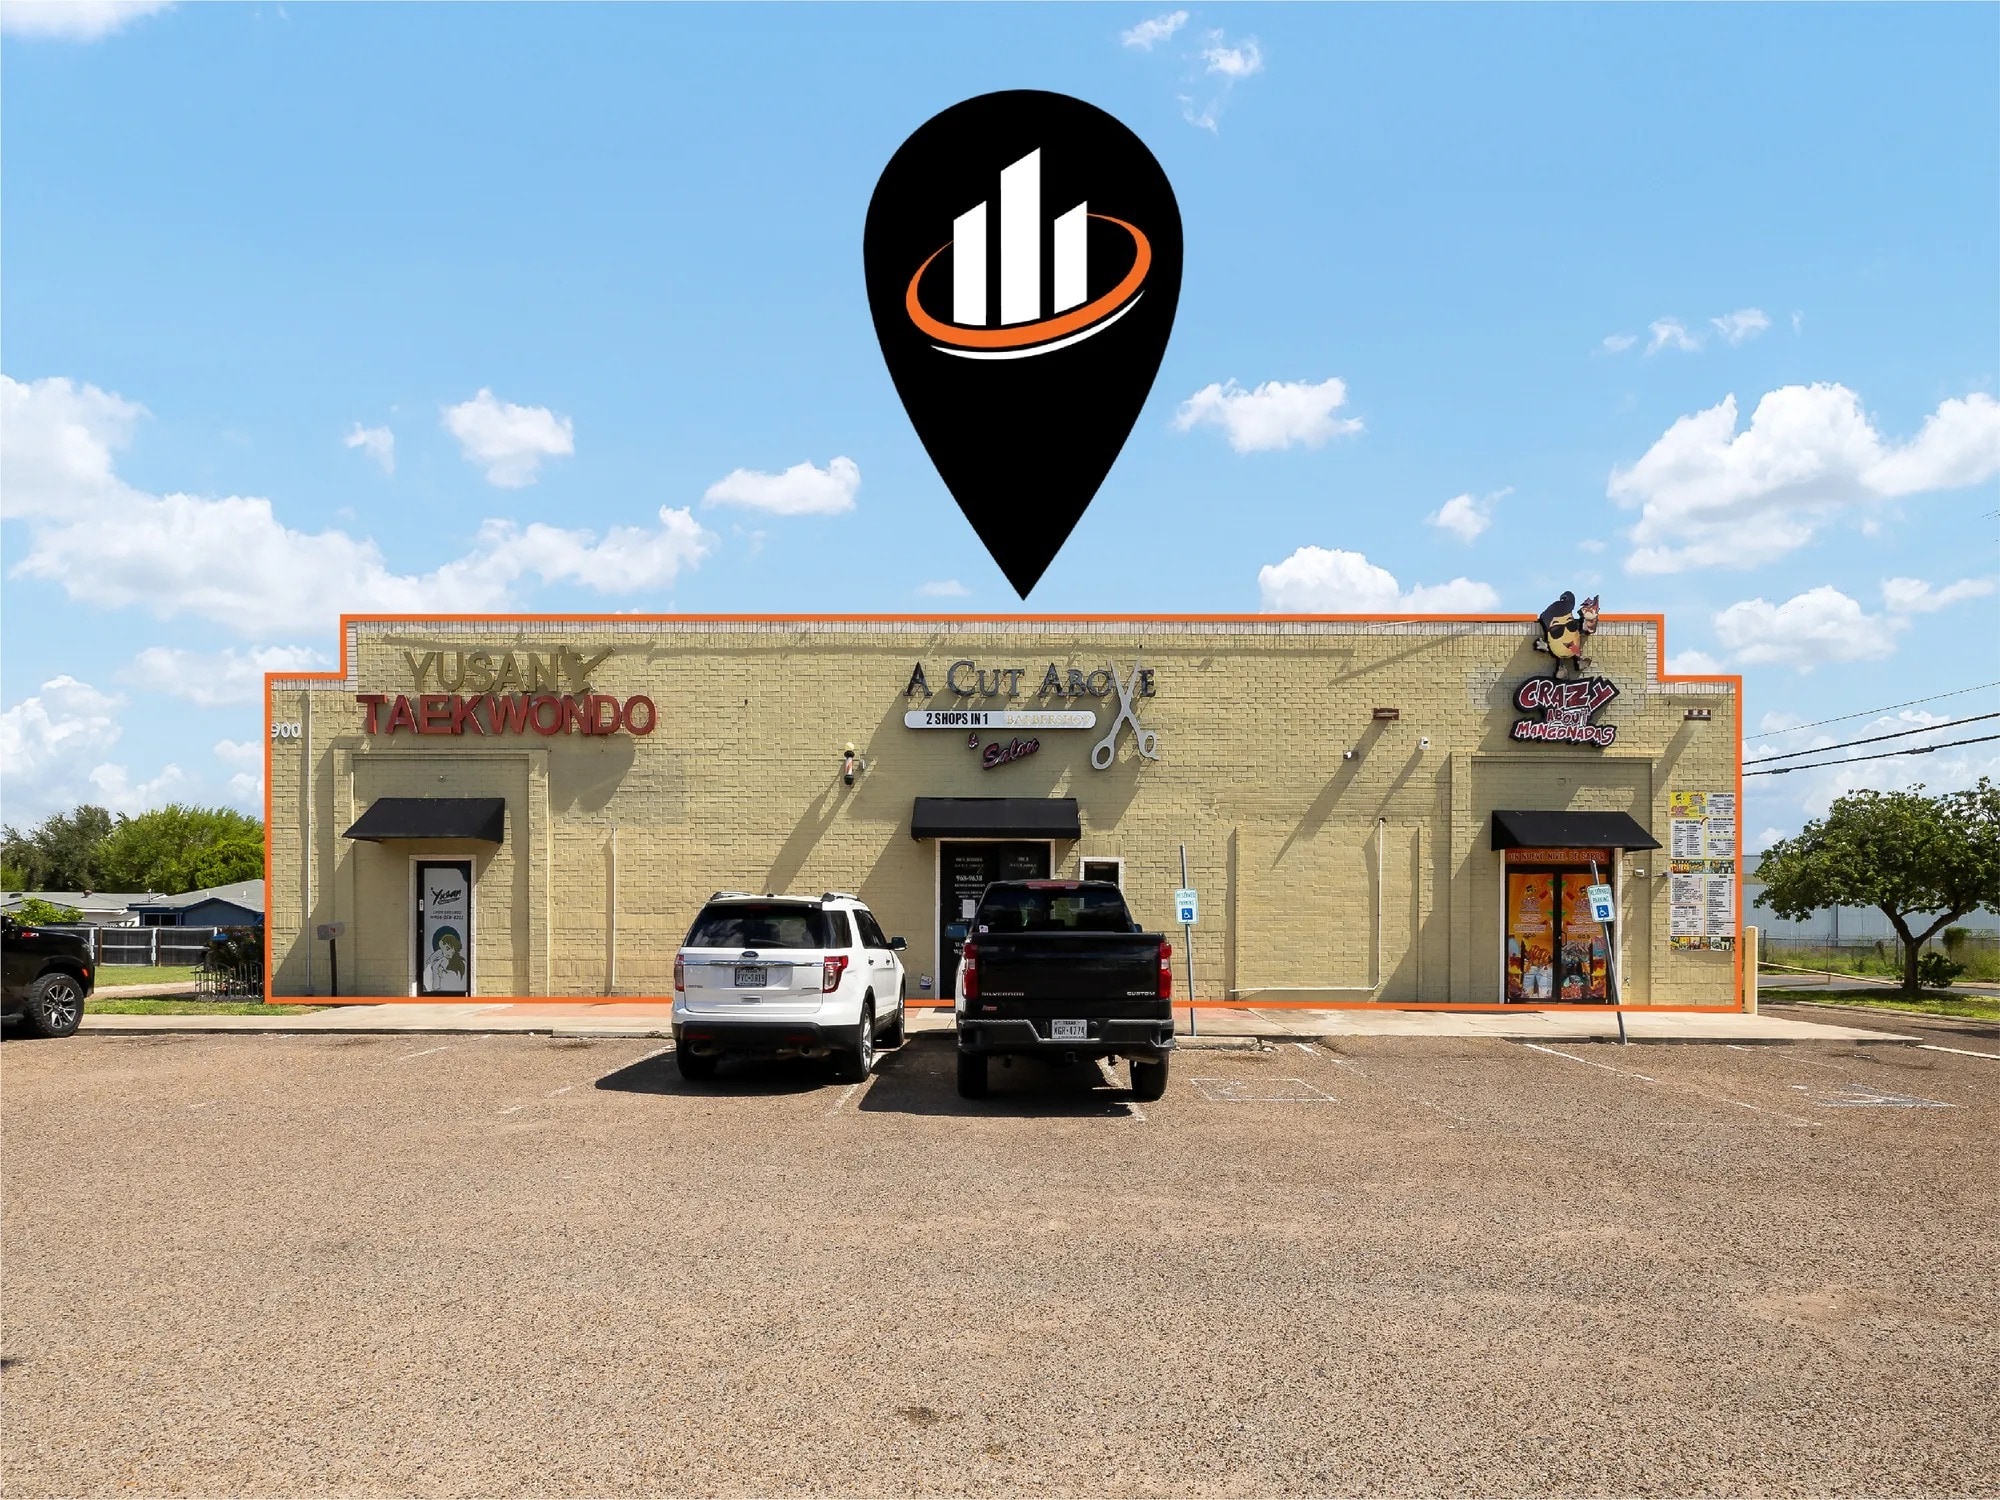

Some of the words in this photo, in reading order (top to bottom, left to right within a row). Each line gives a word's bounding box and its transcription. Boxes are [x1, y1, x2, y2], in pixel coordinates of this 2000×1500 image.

[403, 651, 558, 693] YUSAN
[903, 661, 933, 698] A
[1519, 680, 1614, 712] CRAZY
[356, 694, 658, 736] TAEKWONDO
[926, 713, 933, 725] 2
[935, 712, 968, 726] SHOPS
[970, 712, 981, 725] IN
[983, 712, 989, 725] 1
[1006, 714, 1091, 725] BARBERSHOP
[1546, 708, 1591, 727] ABOUT
[1514, 721, 1615, 745] MANGONADAS
[982, 737, 1041, 770] Salon
[1521, 851, 1545, 861] NUEVO
[1548, 851, 1568, 861] NIVEL
[1569, 851, 1579, 861] DE
[1592, 895, 1610, 904] PARKING
